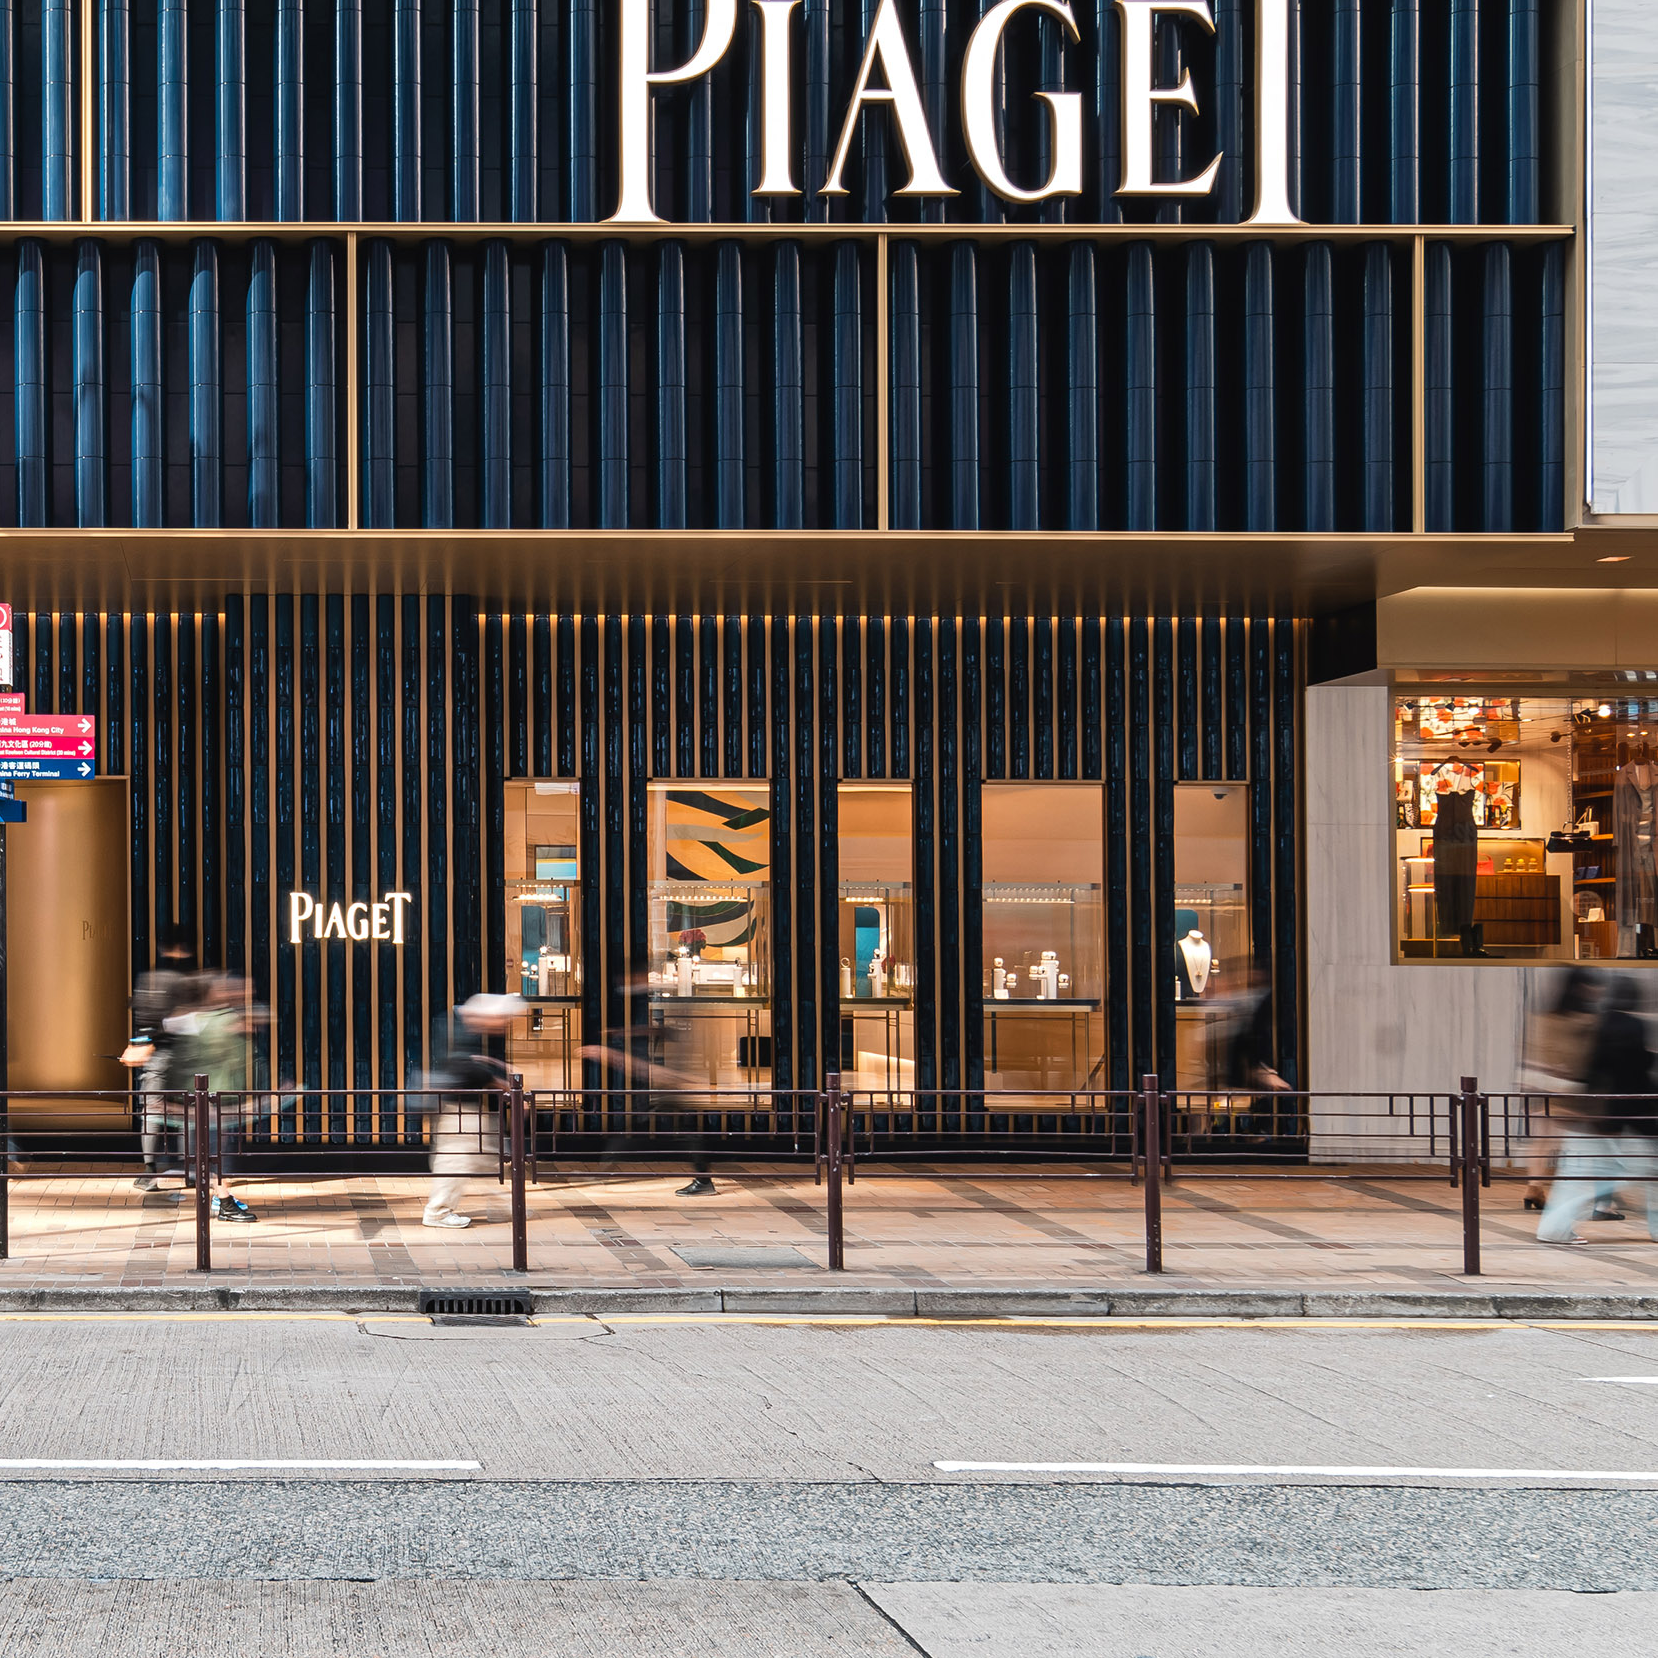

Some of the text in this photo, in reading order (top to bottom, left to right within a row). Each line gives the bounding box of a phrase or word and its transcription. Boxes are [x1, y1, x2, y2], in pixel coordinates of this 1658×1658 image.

[13, 726, 31, 735] Hong
[32, 726, 50, 735] Kong
[51, 726, 65, 735] City
[13, 770, 30, 778] Ferry
[289, 892, 412, 944] PIAGET
